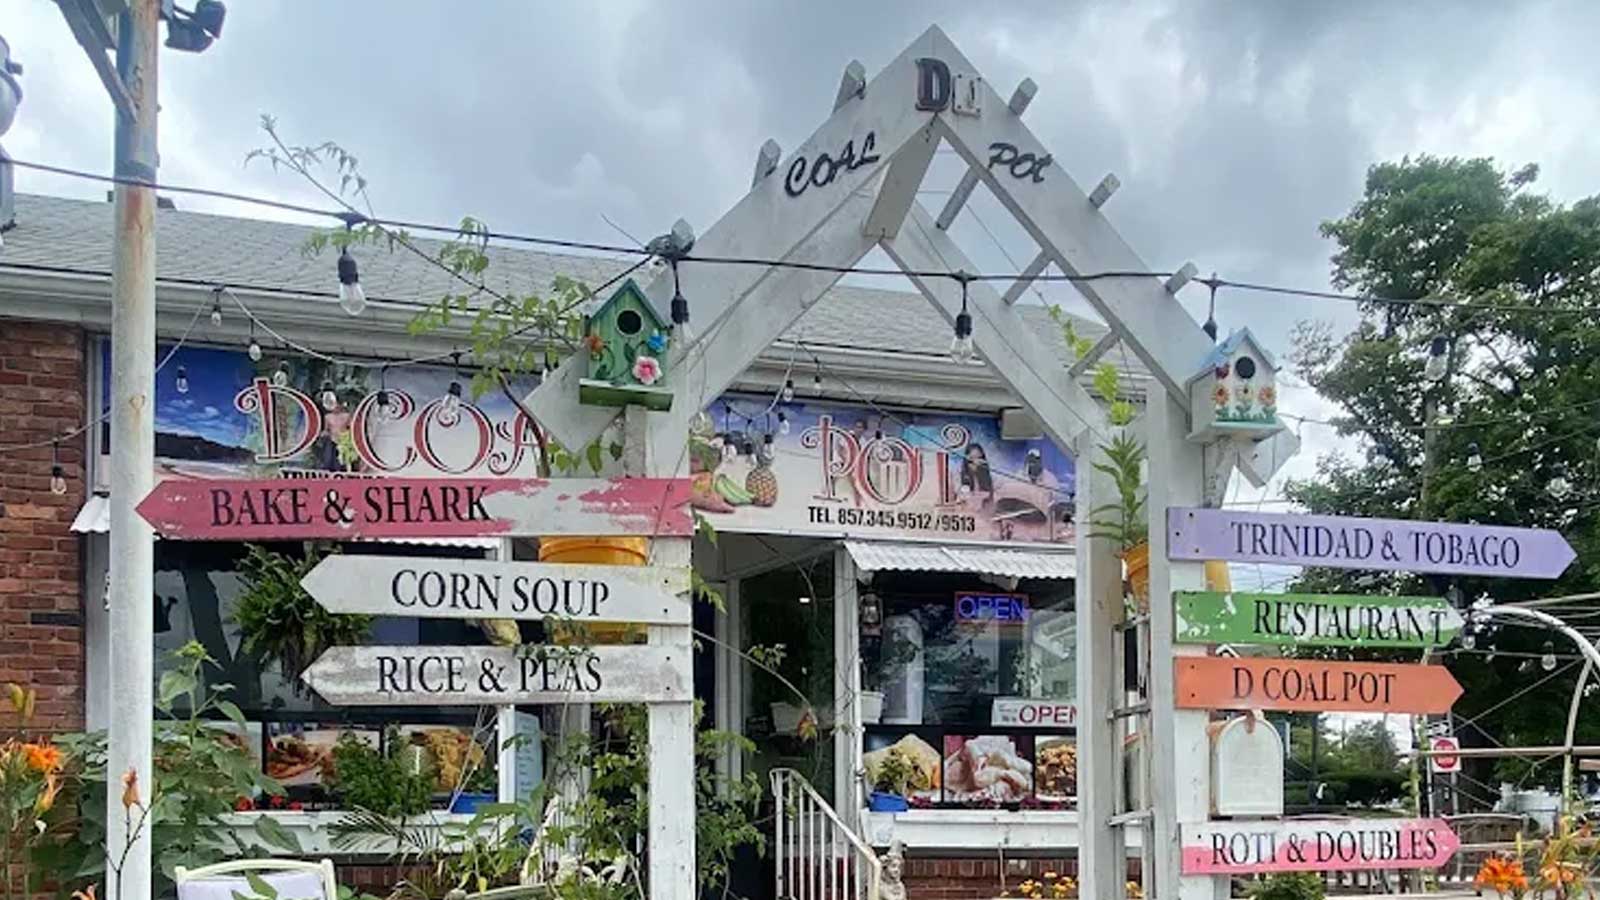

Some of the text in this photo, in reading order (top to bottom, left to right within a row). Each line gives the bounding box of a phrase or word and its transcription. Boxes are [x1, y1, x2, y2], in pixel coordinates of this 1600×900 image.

[915, 57, 950, 112] D
[235, 377, 548, 475] D COA
[209, 485, 491, 527] BAKE & SHARK
[1231, 521, 1520, 569] TRINIDAD & TOBAGO
[391, 569, 609, 617] CORN SOUP
[958, 596, 1025, 619] OPEN
[1254, 599, 1447, 645] RESTAURANT
[376, 656, 602, 693] RICE & PEAS
[1232, 666, 1396, 704] D COAL POT
[1211, 828, 1437, 865] ROTI & DOUBLES
